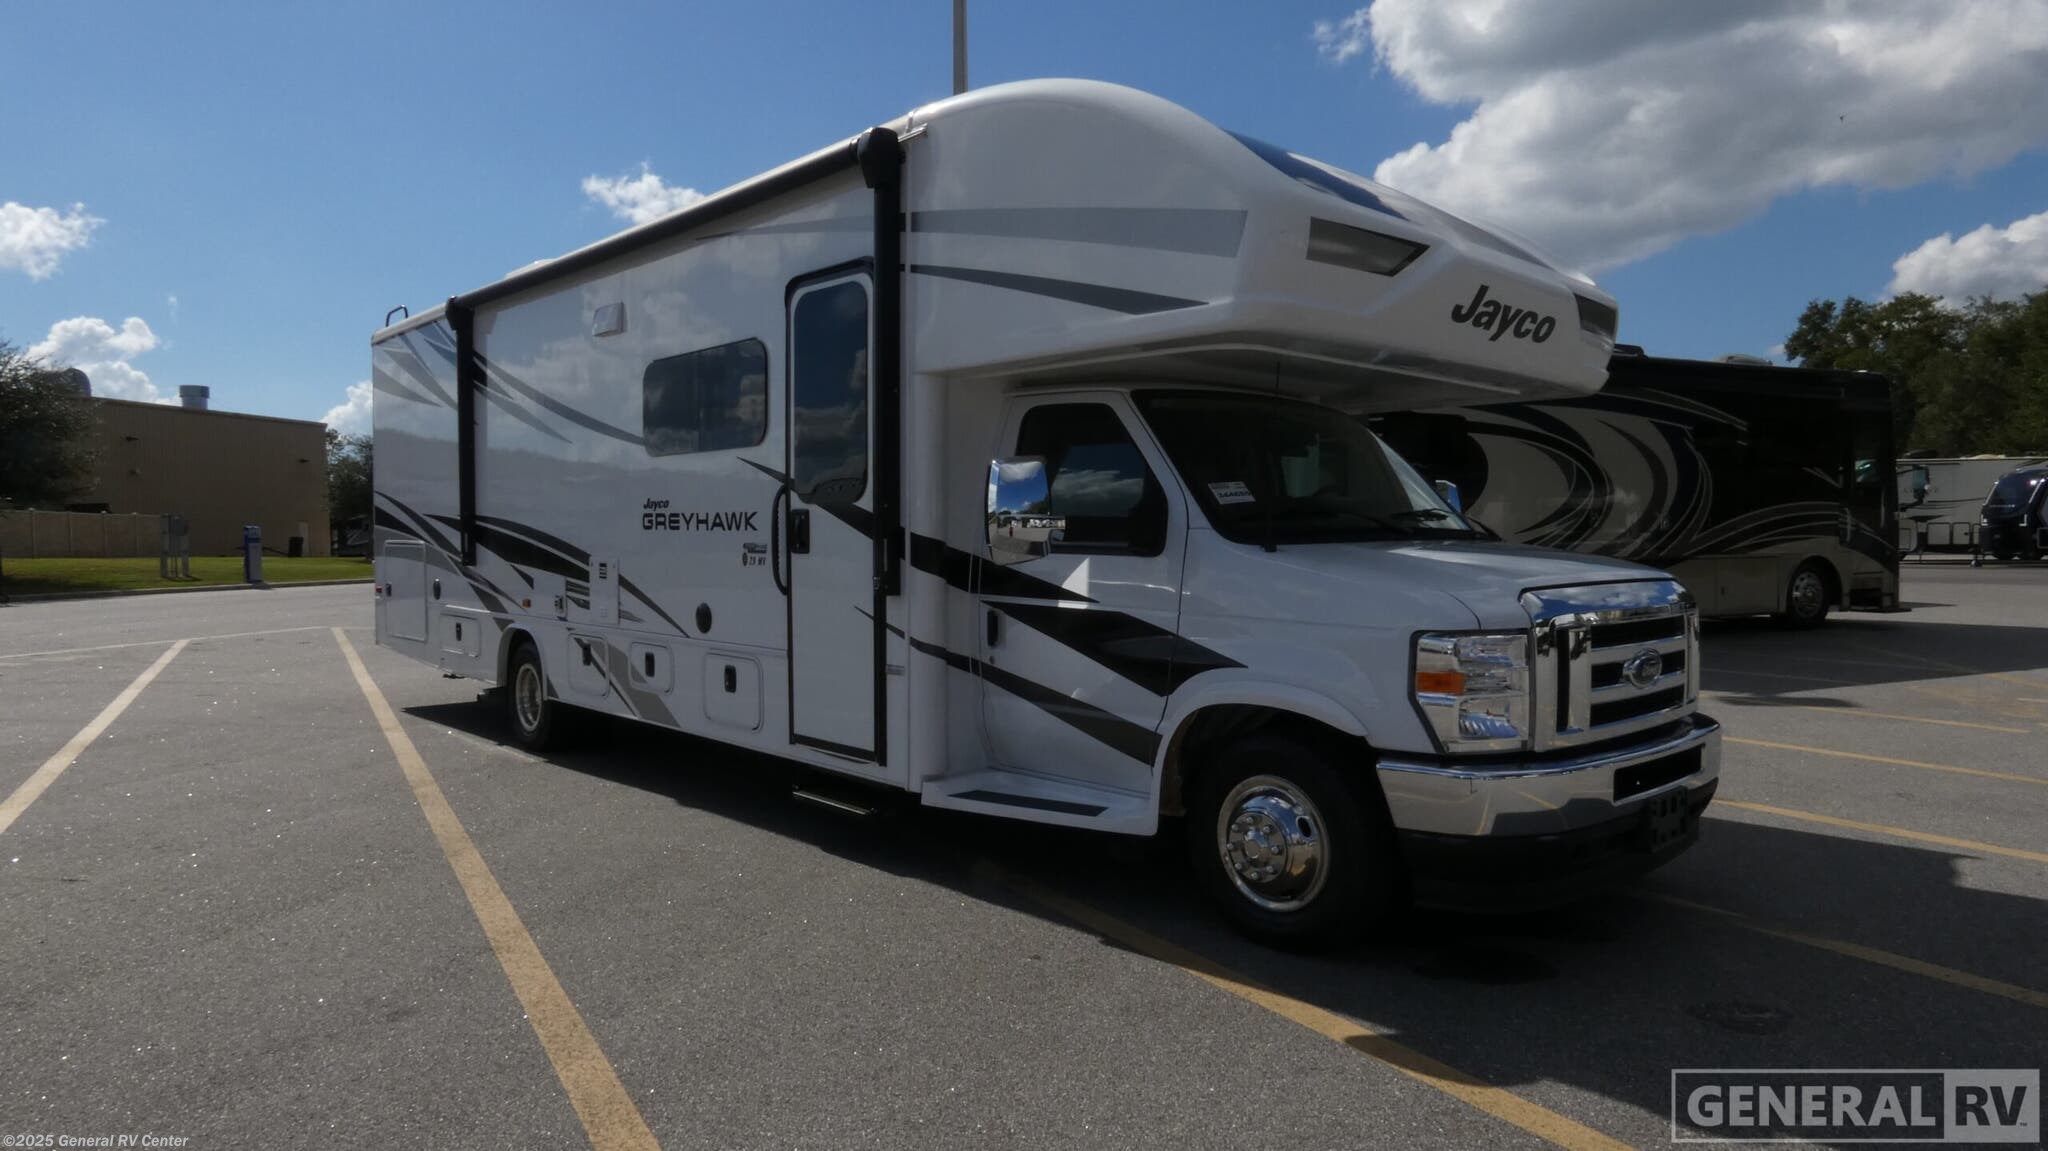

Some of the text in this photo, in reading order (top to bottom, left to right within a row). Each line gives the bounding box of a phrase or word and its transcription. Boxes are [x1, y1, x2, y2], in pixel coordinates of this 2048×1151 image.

[1451, 284, 1556, 343] Jayco
[643, 498, 670, 511] Jayco
[642, 511, 758, 531] GREYHAWK
